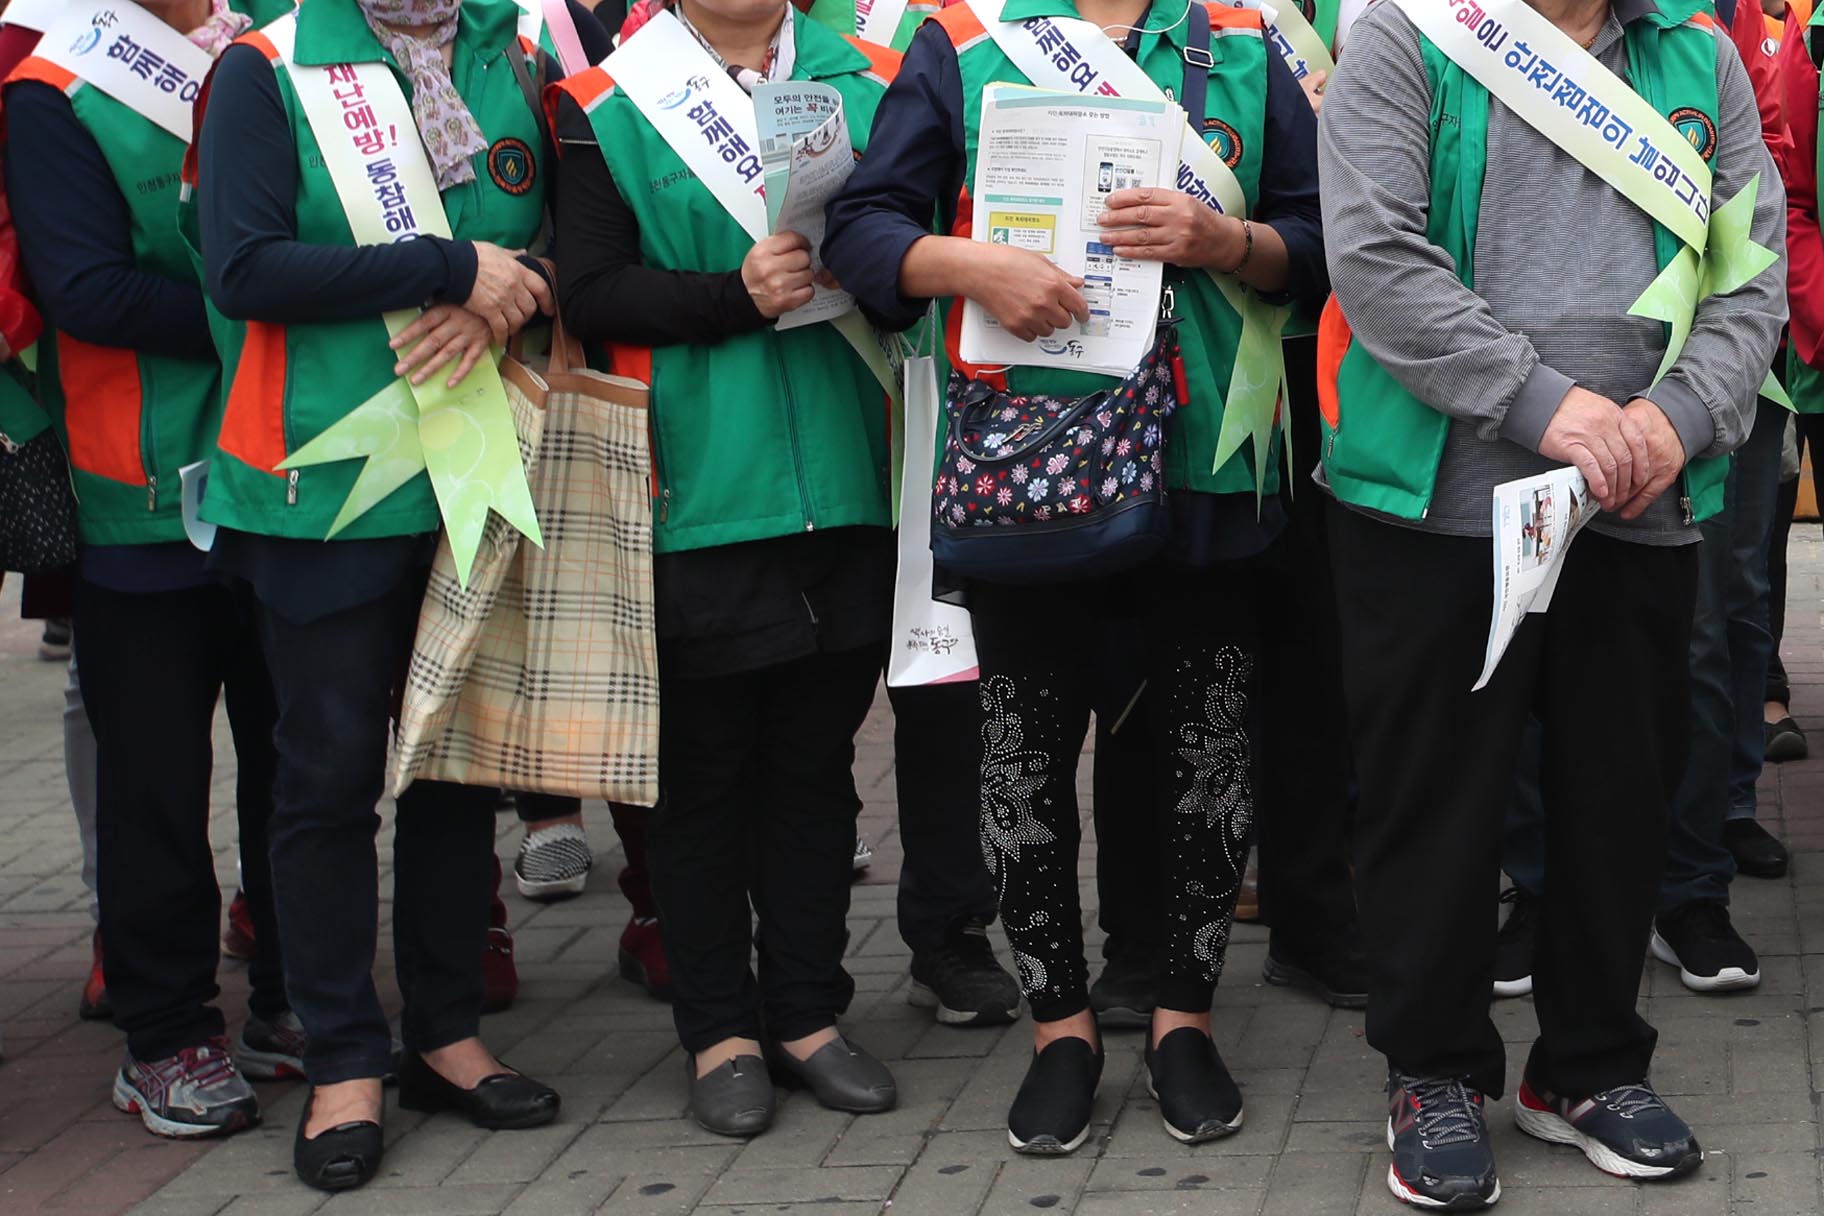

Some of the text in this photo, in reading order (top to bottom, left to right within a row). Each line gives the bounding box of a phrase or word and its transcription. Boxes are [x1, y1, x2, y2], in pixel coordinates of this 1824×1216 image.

[322, 63, 399, 157] 재난예방!
[685, 99, 764, 184] 함께해요
[1504, 40, 1633, 150] 안전점검의
